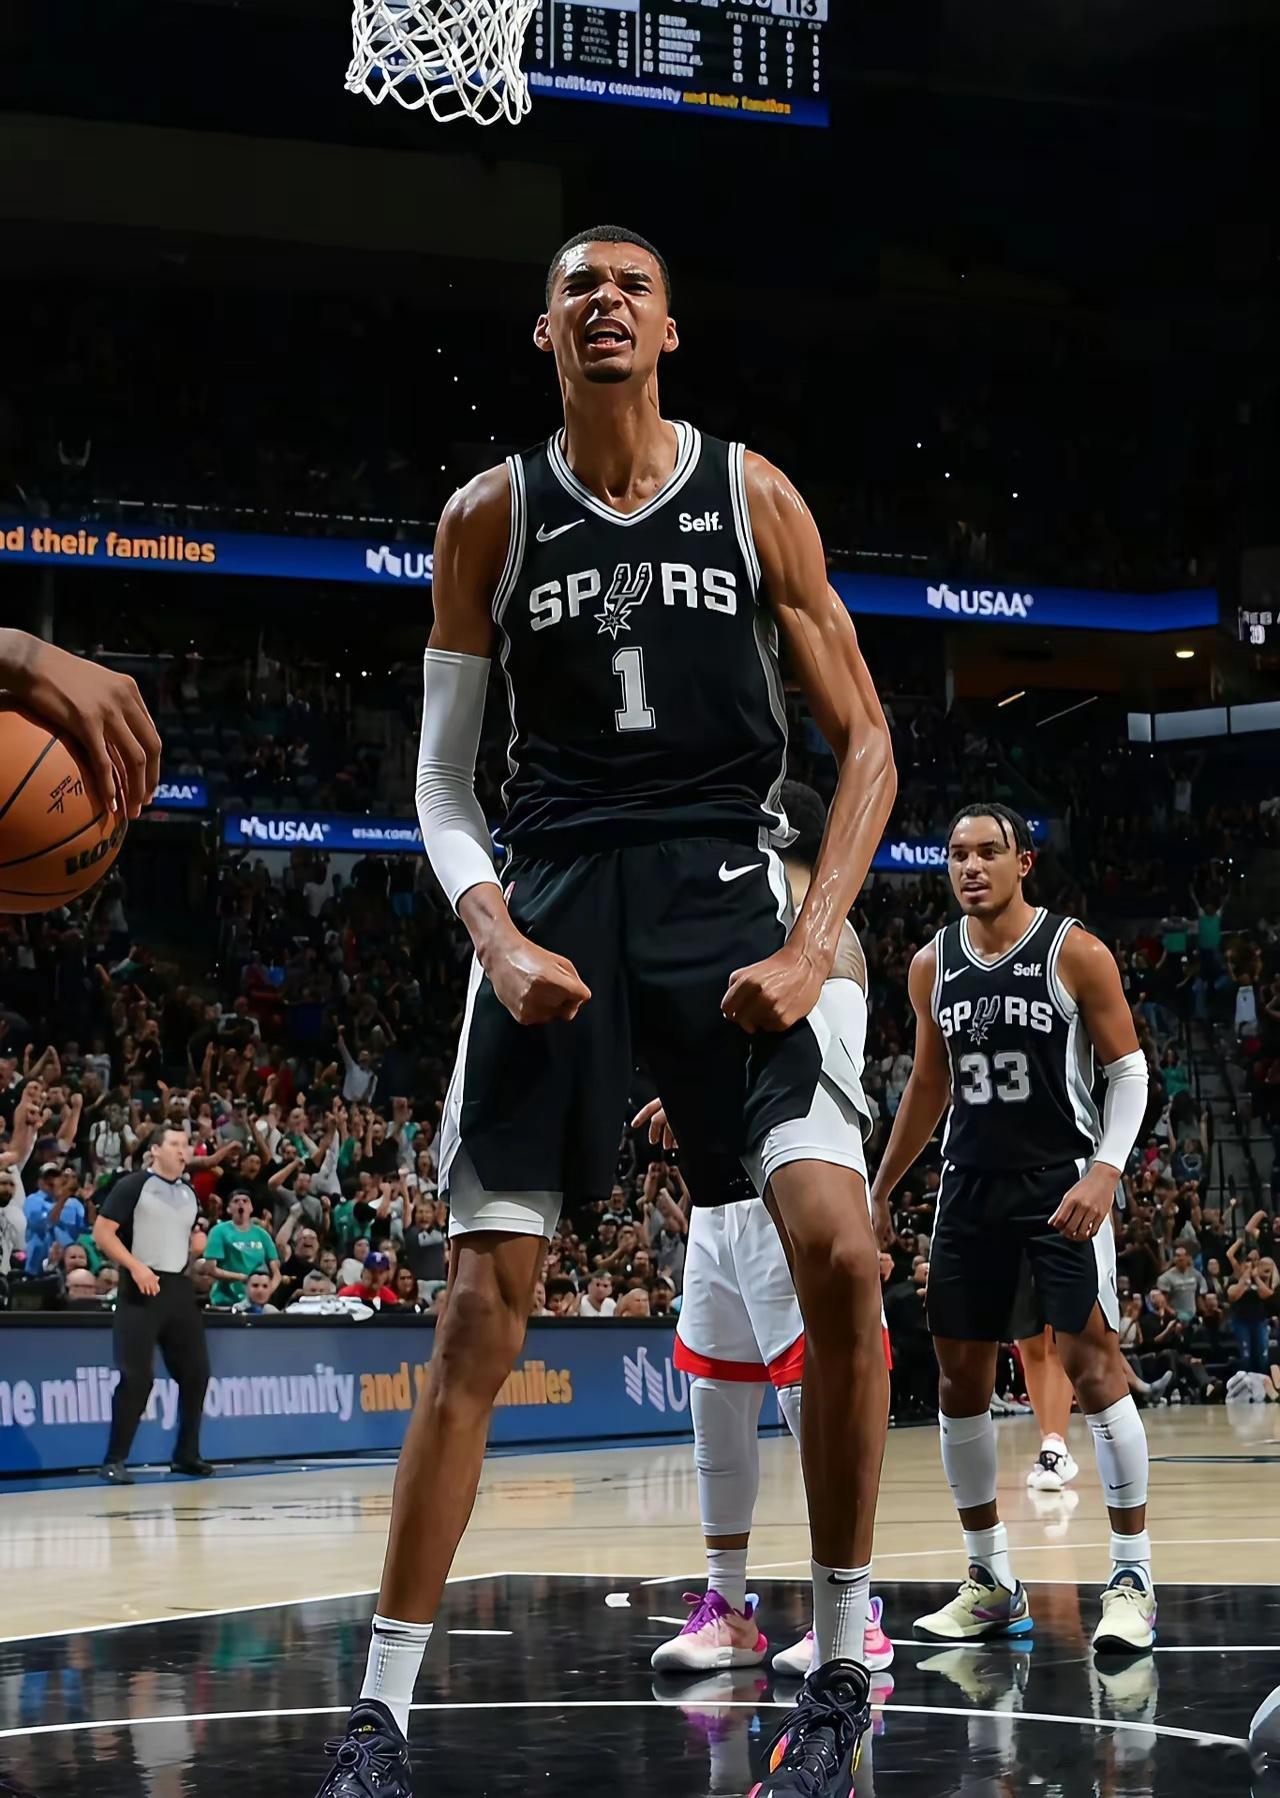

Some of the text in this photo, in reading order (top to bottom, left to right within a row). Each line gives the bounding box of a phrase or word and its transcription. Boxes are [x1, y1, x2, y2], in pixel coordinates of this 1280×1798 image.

[31, 527, 99, 556] their
[105, 531, 216, 563] families
[404, 552, 434, 580] US
[612, 646, 656, 732] 1
[915, 846, 949, 865] USA
[960, 1052, 1031, 1105] 33
[203, 1363, 354, 1422] ommunity
[359, 1362, 413, 1412] and
